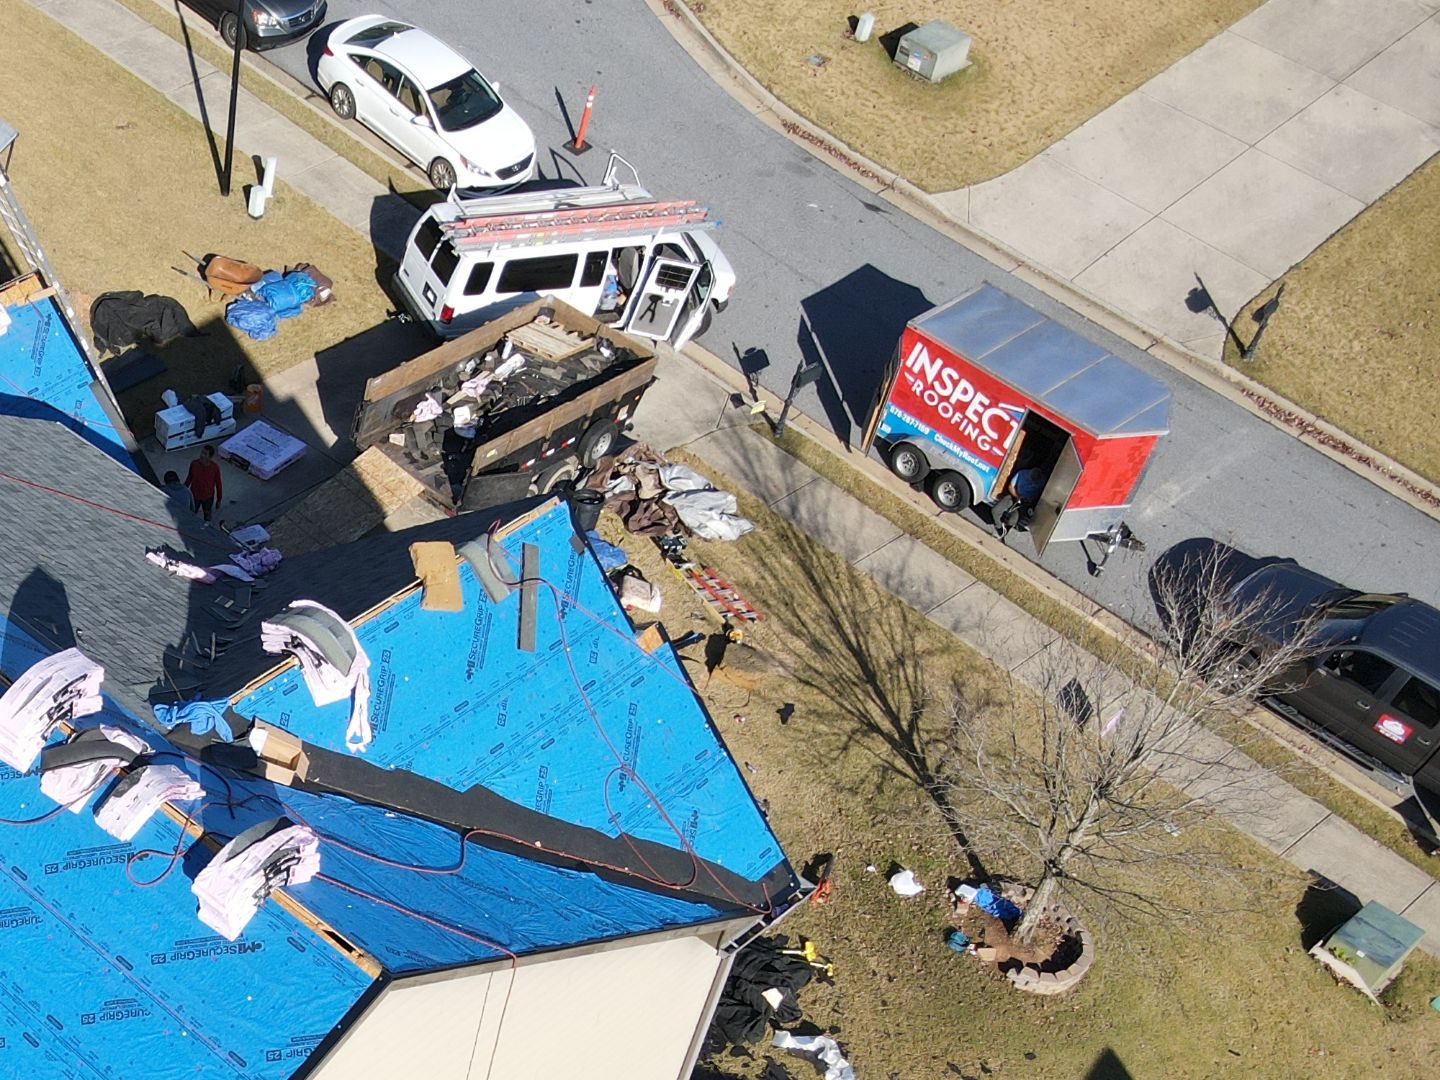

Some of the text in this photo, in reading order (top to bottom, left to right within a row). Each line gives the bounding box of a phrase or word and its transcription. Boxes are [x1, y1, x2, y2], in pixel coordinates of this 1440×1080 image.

[911, 377, 993, 451] ROOFING
[150, 954, 165, 964] 25
[265, 1049, 281, 1061] 25
